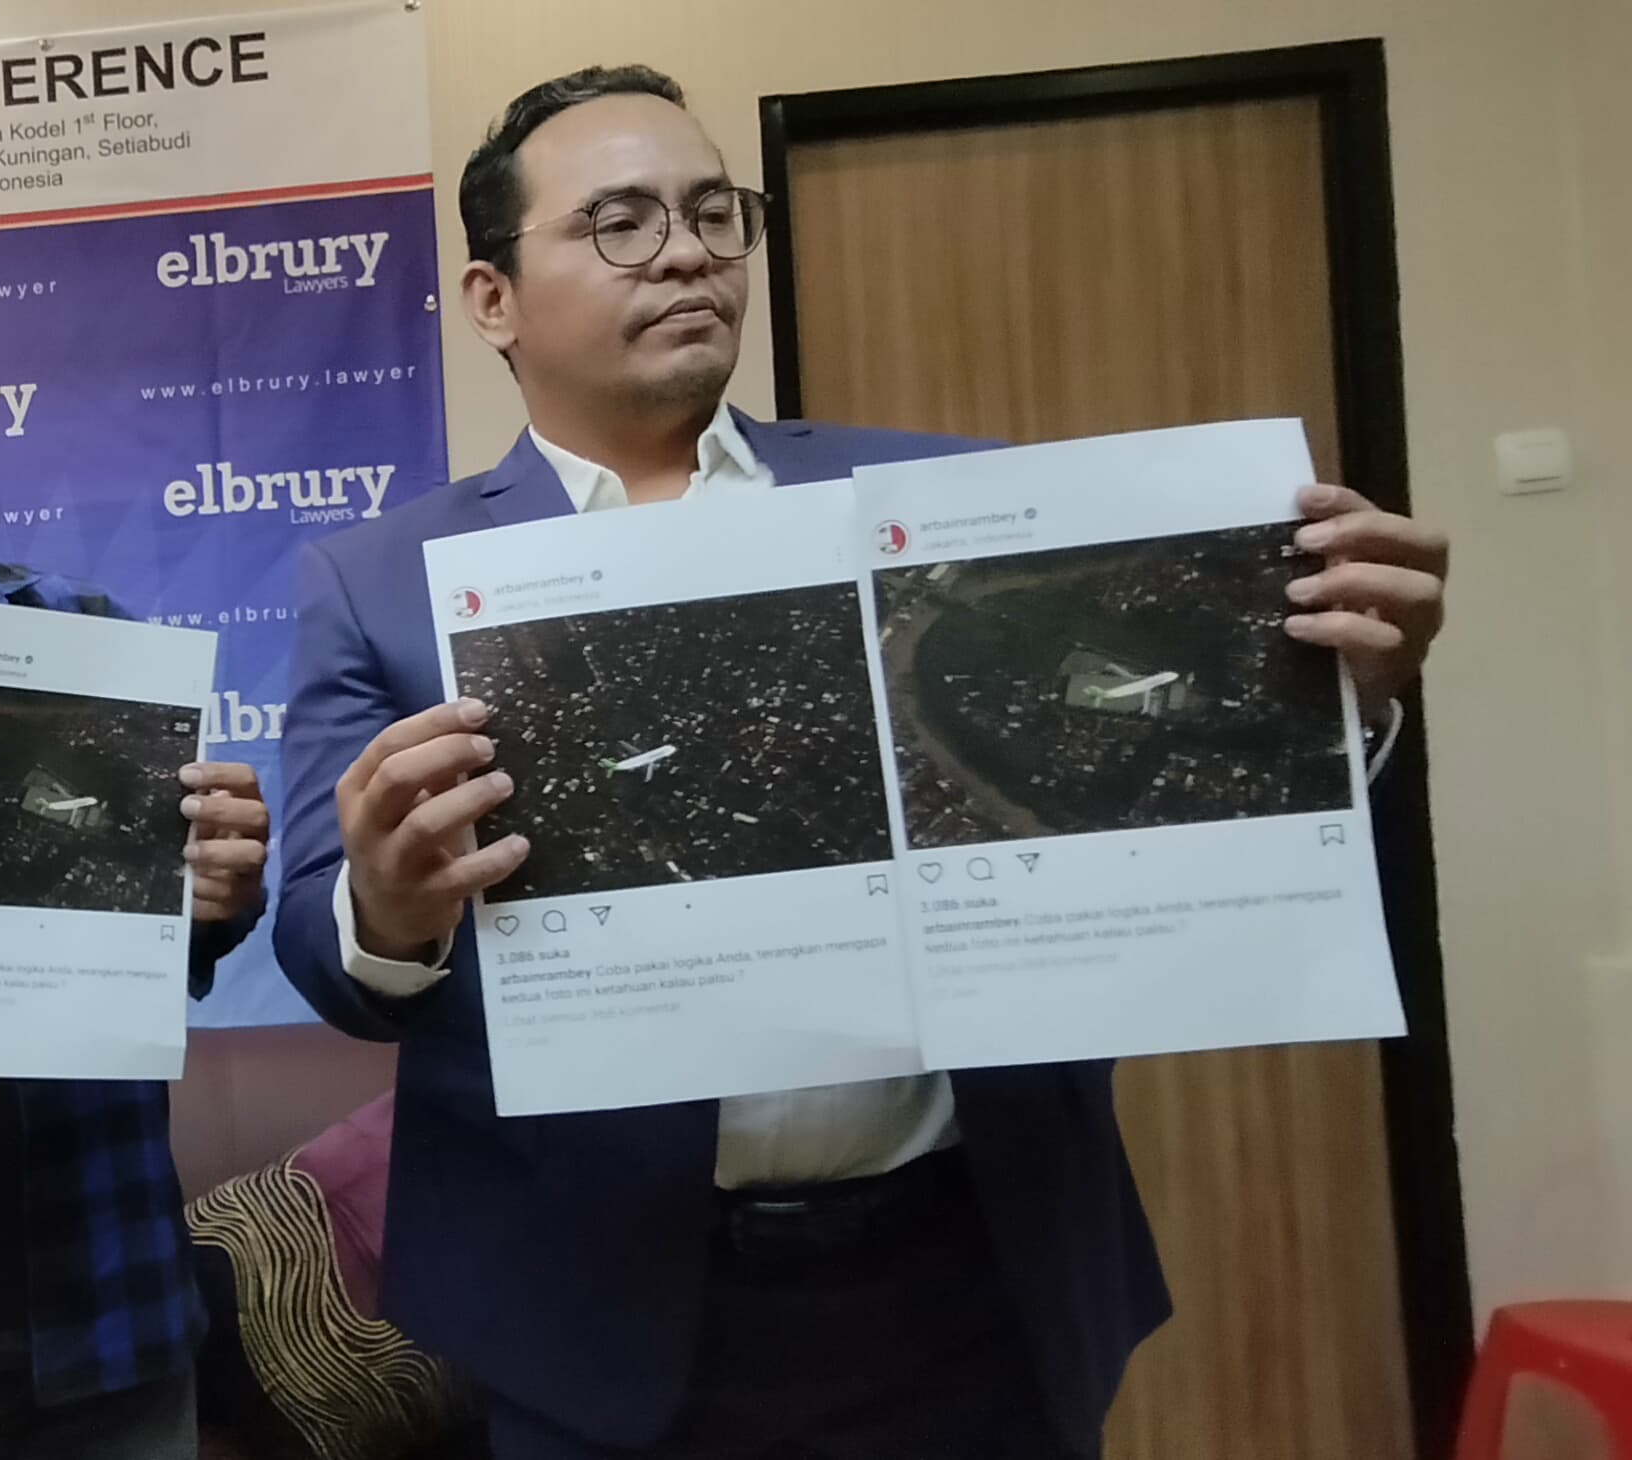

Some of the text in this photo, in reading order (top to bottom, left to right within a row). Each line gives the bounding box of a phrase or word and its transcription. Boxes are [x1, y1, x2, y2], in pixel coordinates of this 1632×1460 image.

[9, 119, 66, 140] Kodel
[72, 112, 95, 135] 1st
[102, 112, 158, 132] Floor,
[97, 129, 191, 158] Setiabudi
[155, 231, 390, 289] elbrury
[283, 274, 349, 296] Lawyers
[140, 363, 418, 402] www.elbrury.lawyer
[163, 461, 396, 519] elbrury
[289, 507, 356, 526] Lawyers
[537, 948, 571, 961] suka
[594, 963, 632, 977] Coba
[634, 959, 670, 976] pakai
[672, 955, 713, 972] logika
[824, 935, 888, 952] mengapa
